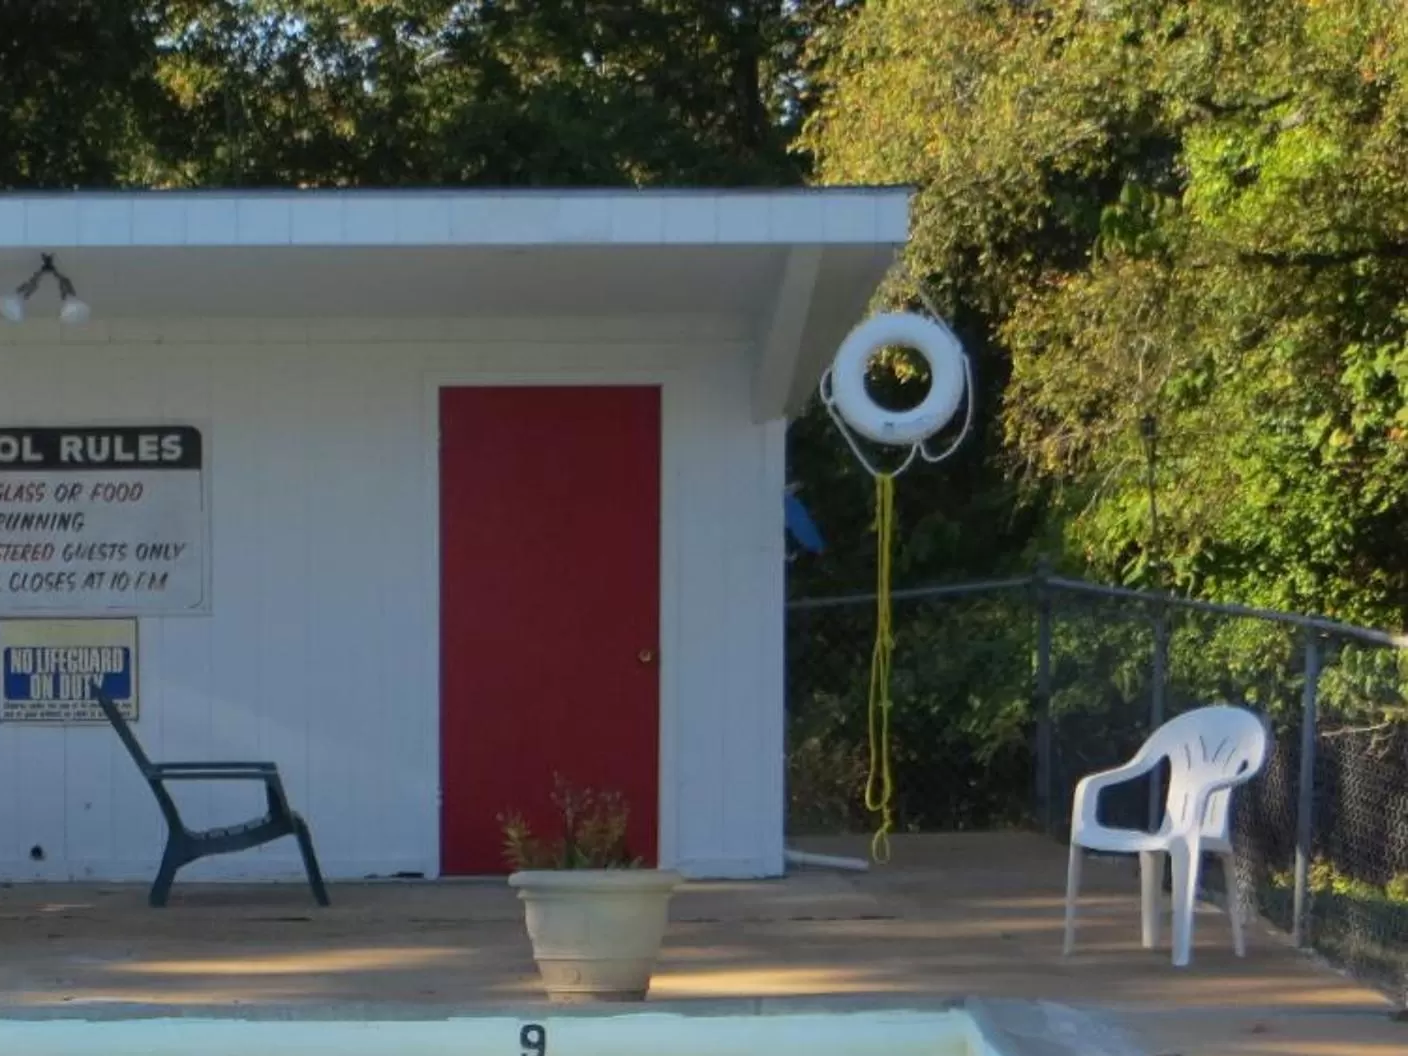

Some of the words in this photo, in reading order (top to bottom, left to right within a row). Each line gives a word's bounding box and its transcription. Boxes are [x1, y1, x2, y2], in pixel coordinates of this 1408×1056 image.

[59, 434, 184, 463] RULES
[54, 482, 83, 502] OR
[90, 481, 144, 503] FOOD
[62, 542, 128, 563] GUESTS
[136, 541, 188, 562] ONLY
[9, 571, 76, 592] CLOSES
[81, 571, 106, 590] AT
[110, 570, 132, 592] 10
[11, 648, 33, 674] NO
[36, 647, 124, 674] LIFEGUARD
[30, 674, 54, 699] ON
